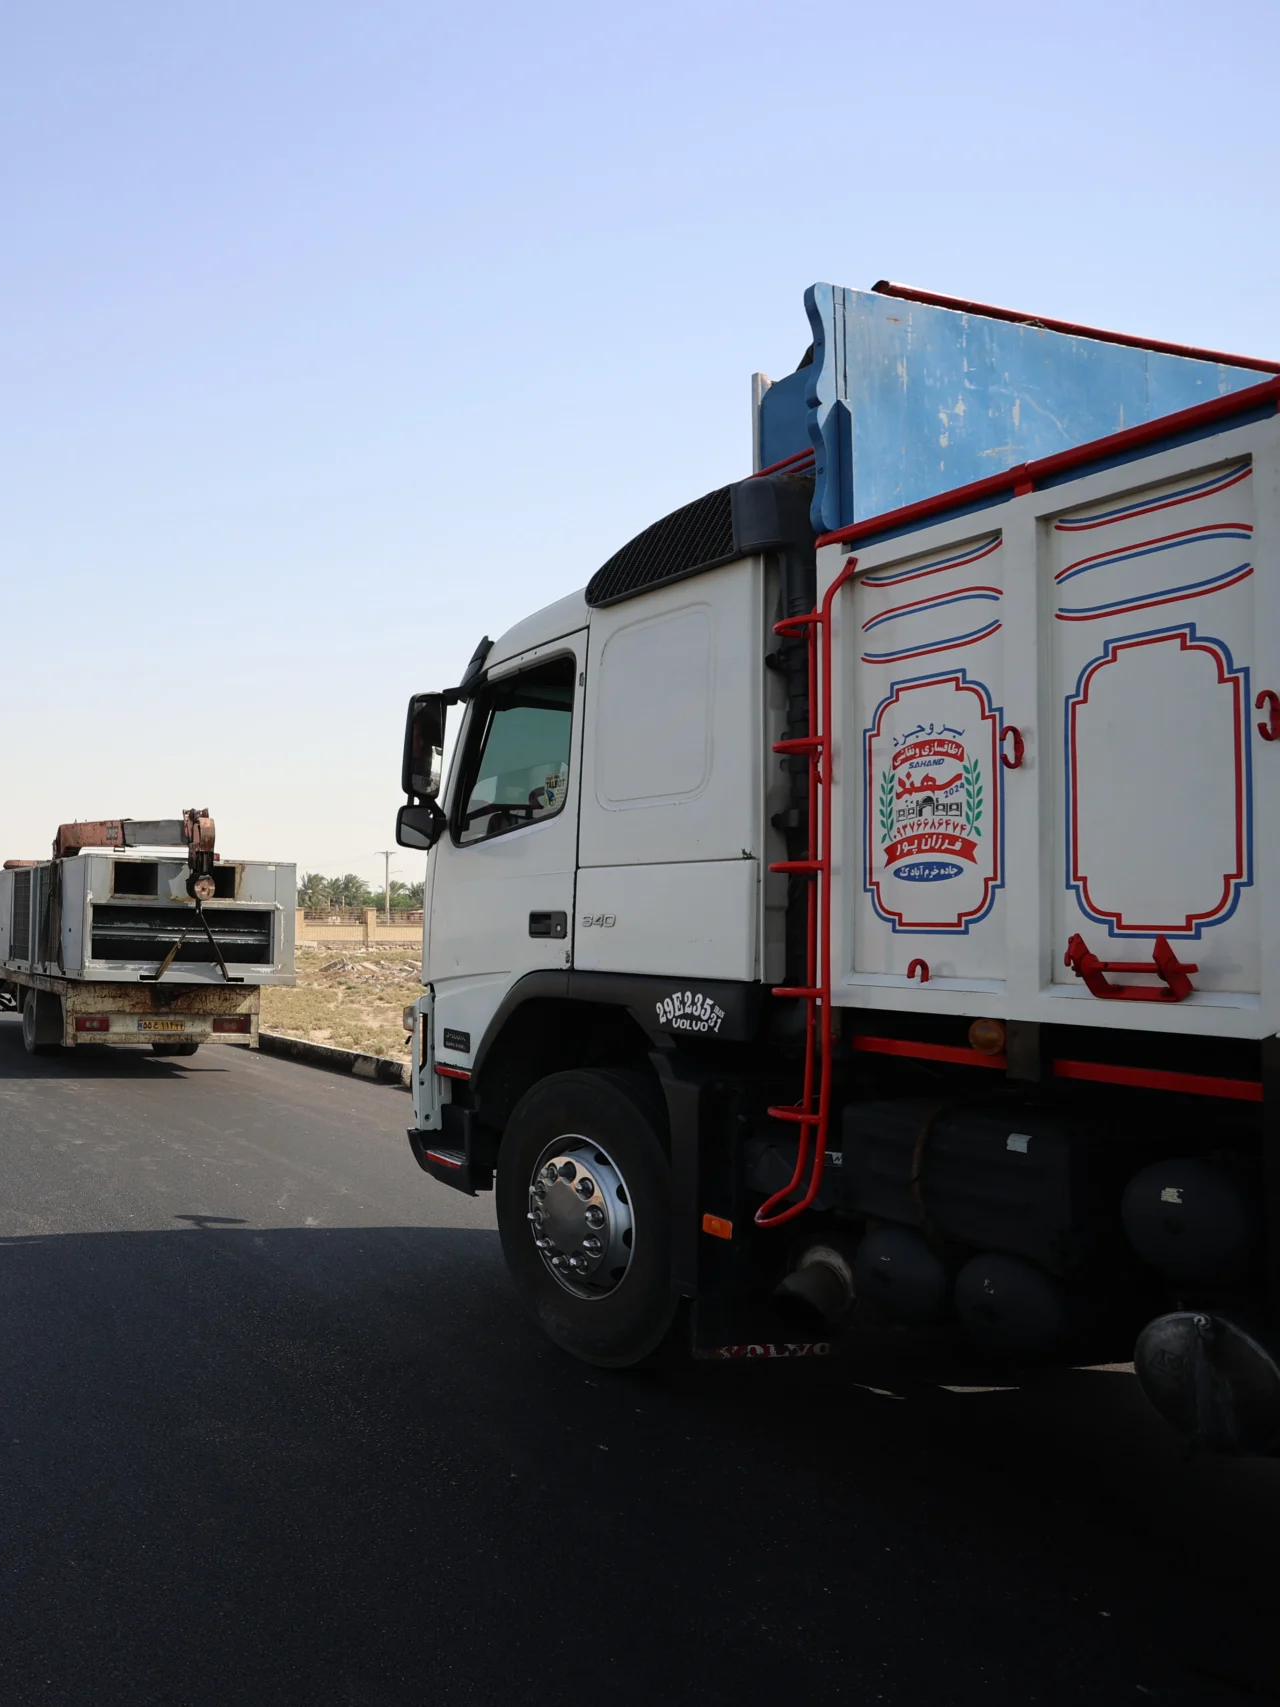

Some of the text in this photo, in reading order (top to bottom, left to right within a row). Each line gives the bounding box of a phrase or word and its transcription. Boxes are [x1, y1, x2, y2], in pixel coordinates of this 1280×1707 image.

[908, 758, 945, 770] SAHAND
[943, 782, 966, 799] 2024
[896, 839, 918, 856] پور
[582, 914, 617, 928] 340
[708, 1012, 722, 1033] 31
